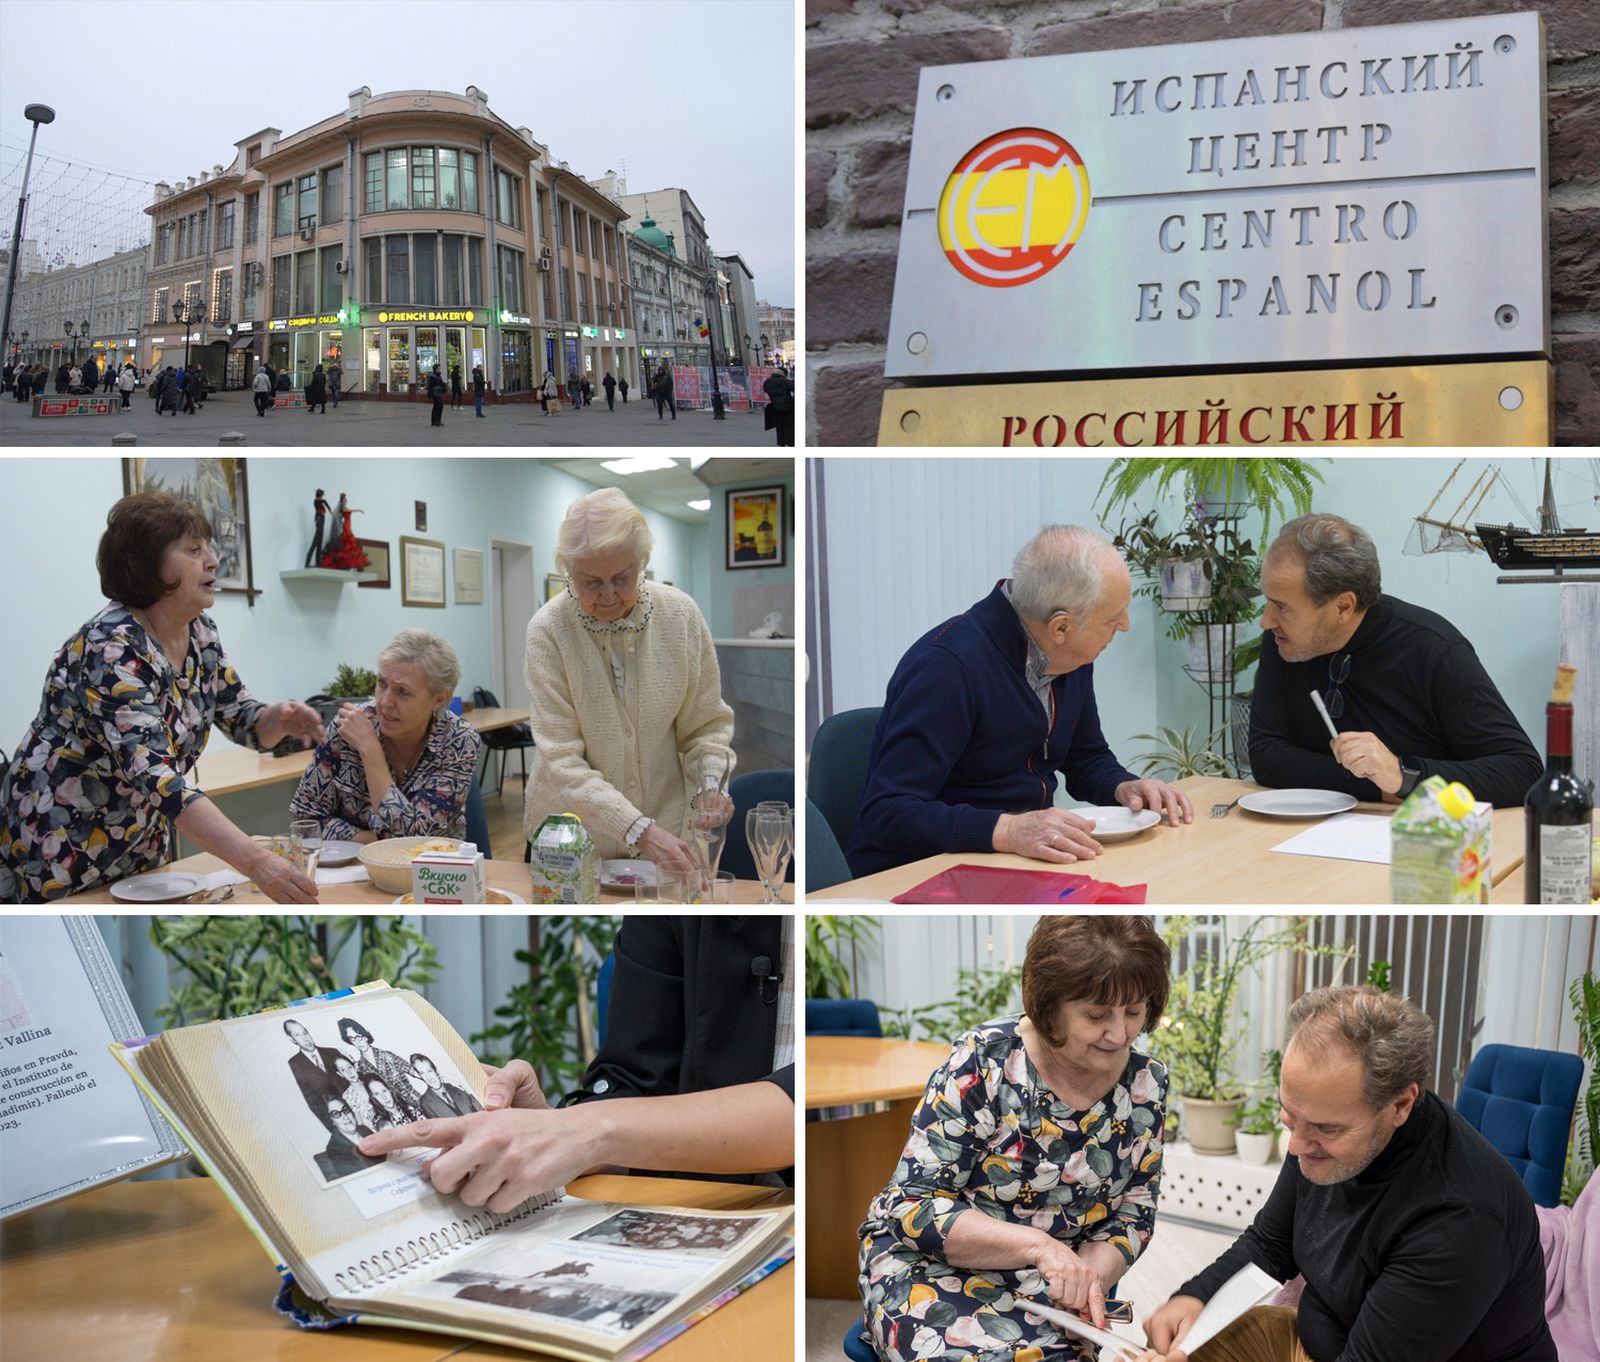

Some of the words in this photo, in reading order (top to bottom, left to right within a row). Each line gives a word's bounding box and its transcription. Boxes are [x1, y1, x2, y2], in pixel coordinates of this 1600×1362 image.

[1109, 41, 1485, 118] ИСПАНСКИЙ
[1187, 122, 1393, 178] ЦЕНТР
[1157, 198, 1419, 254] CENTRO
[1134, 267, 1438, 323] ESPANOL
[388, 312, 426, 321] FRENCH
[428, 312, 466, 321] BAKERY
[1001, 391, 1406, 447] РОССИЙСКИЙ
[418, 867, 467, 885] Вкусно
[4, 1026, 52, 1047] Vallina
[2, 1079, 12, 1090] el
[13, 1066, 59, 1087] Instituto
[60, 1061, 73, 1072] de
[24, 1061, 37, 1070] en
[38, 1048, 78, 1066] Pravda,
[0, 1097, 44, 1118] adimir).
[45, 1082, 86, 1102] Falleció
[87, 1078, 97, 1089] el
[8, 1075, 74, 1101] construcción
[75, 1071, 88, 1080] en
